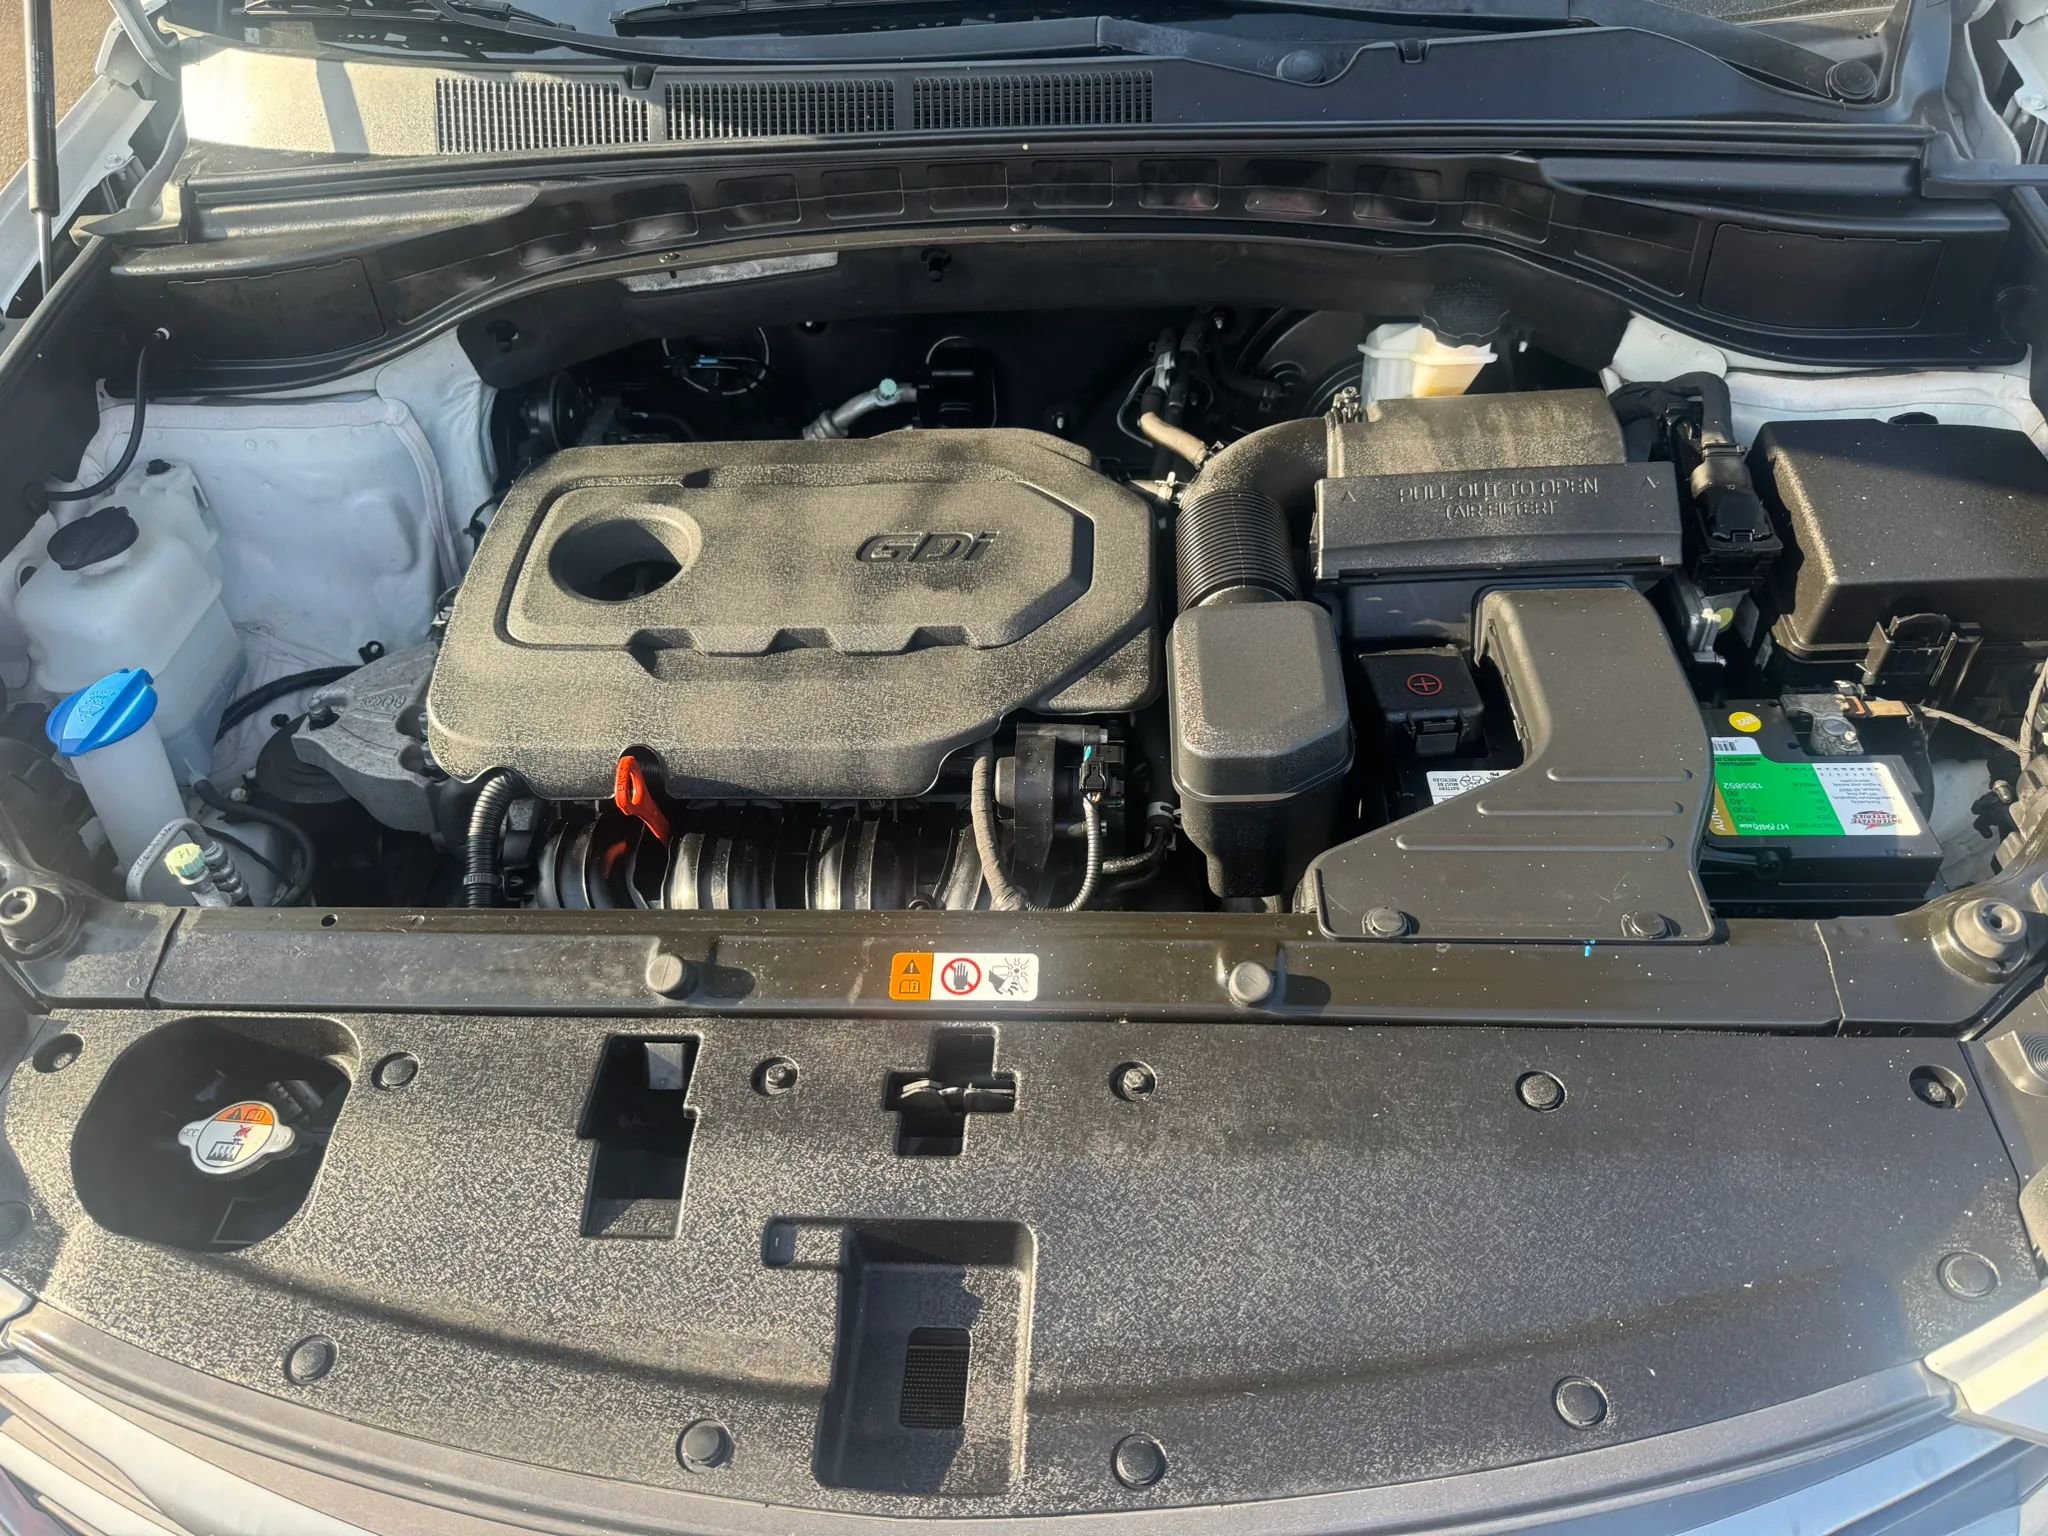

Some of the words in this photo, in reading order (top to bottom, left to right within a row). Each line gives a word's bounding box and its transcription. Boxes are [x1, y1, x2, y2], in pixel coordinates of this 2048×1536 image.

[1399, 483, 1453, 503] PULL
[1458, 481, 1501, 500] OUT
[1511, 479, 1535, 498] TO
[1540, 477, 1599, 496] OPEN
[1445, 503, 1482, 520] (AIR
[1487, 499, 1558, 517] FILTER)
[855, 530, 1000, 563] GDi
[1722, 782, 1764, 790] 1355852
[1712, 806, 1726, 832] AUTO
[1775, 823, 1790, 831] H7
